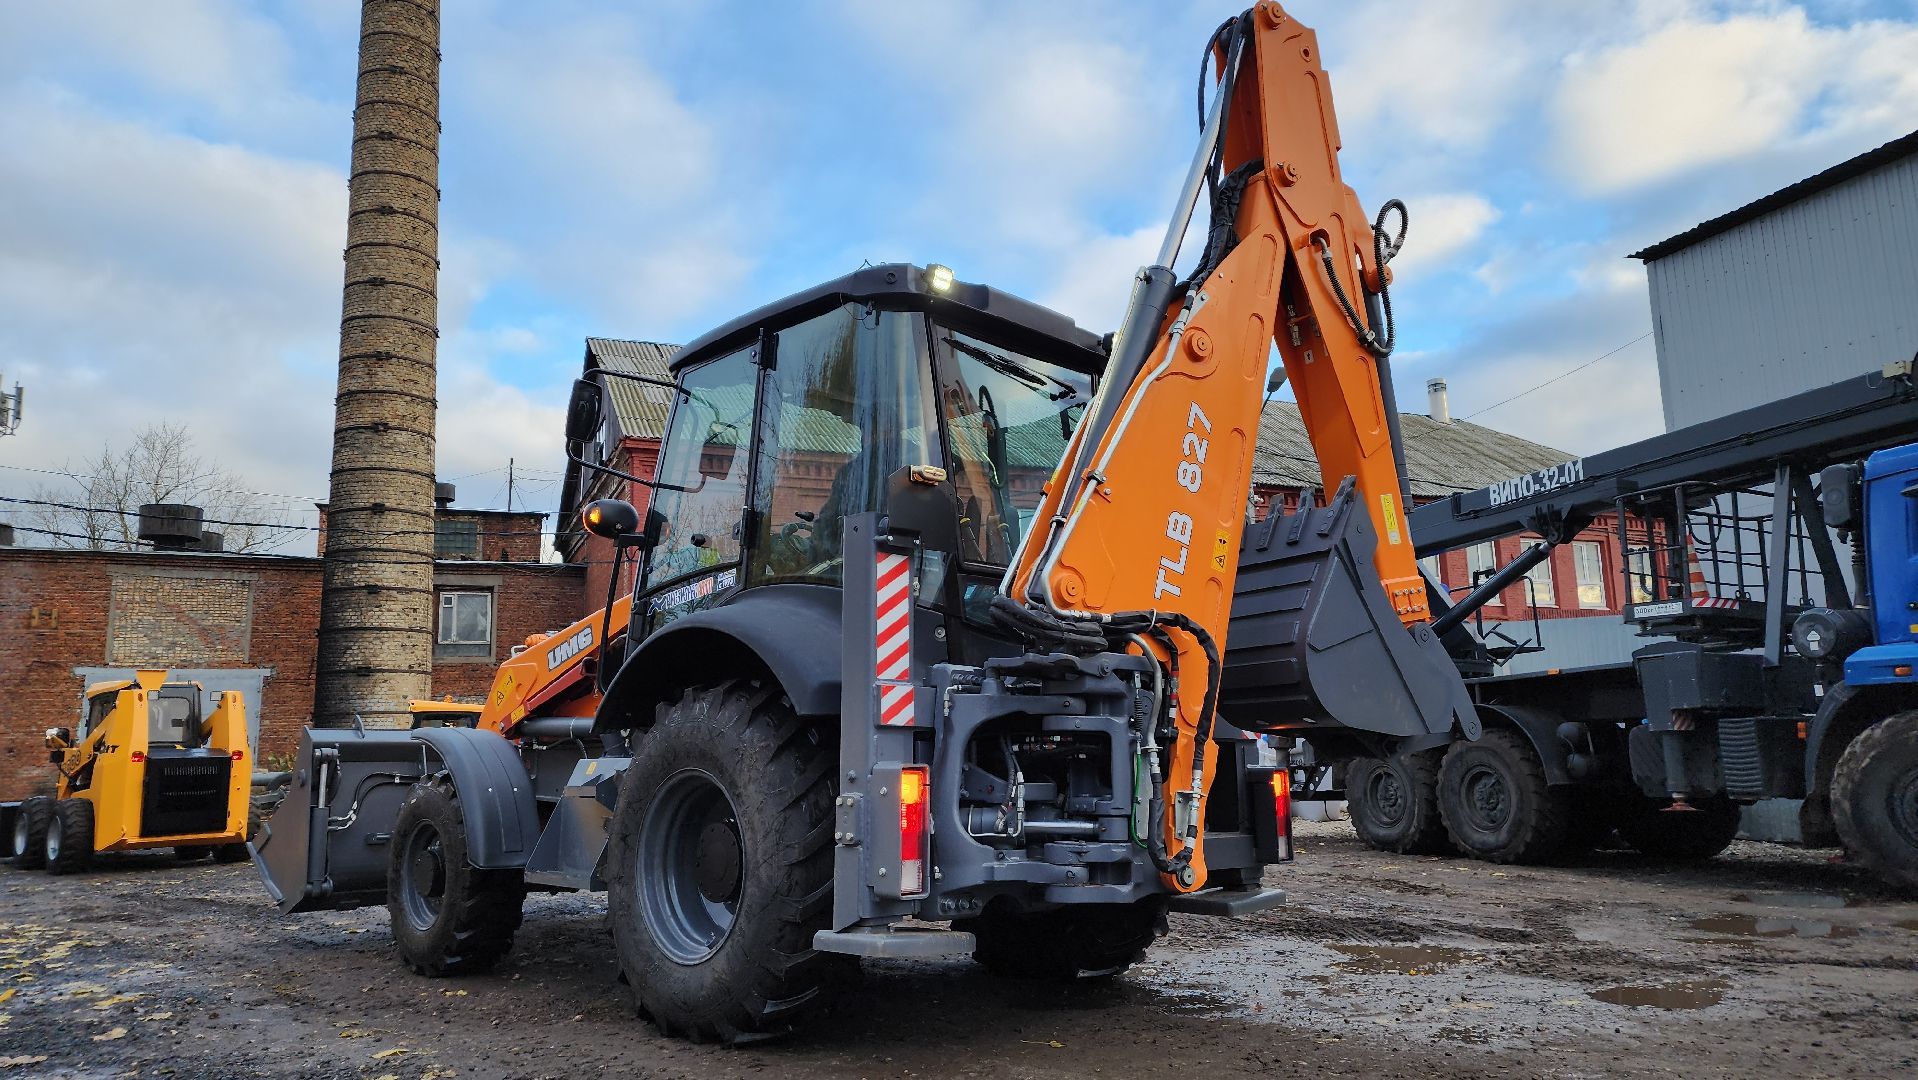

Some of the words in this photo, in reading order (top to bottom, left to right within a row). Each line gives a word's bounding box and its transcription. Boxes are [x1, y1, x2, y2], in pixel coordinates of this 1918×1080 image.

[1154, 511, 1193, 600] TLB
[1176, 400, 1212, 494] 827
[1488, 457, 1584, 507] ВИПО-32-01
[547, 627, 592, 670] UMG
